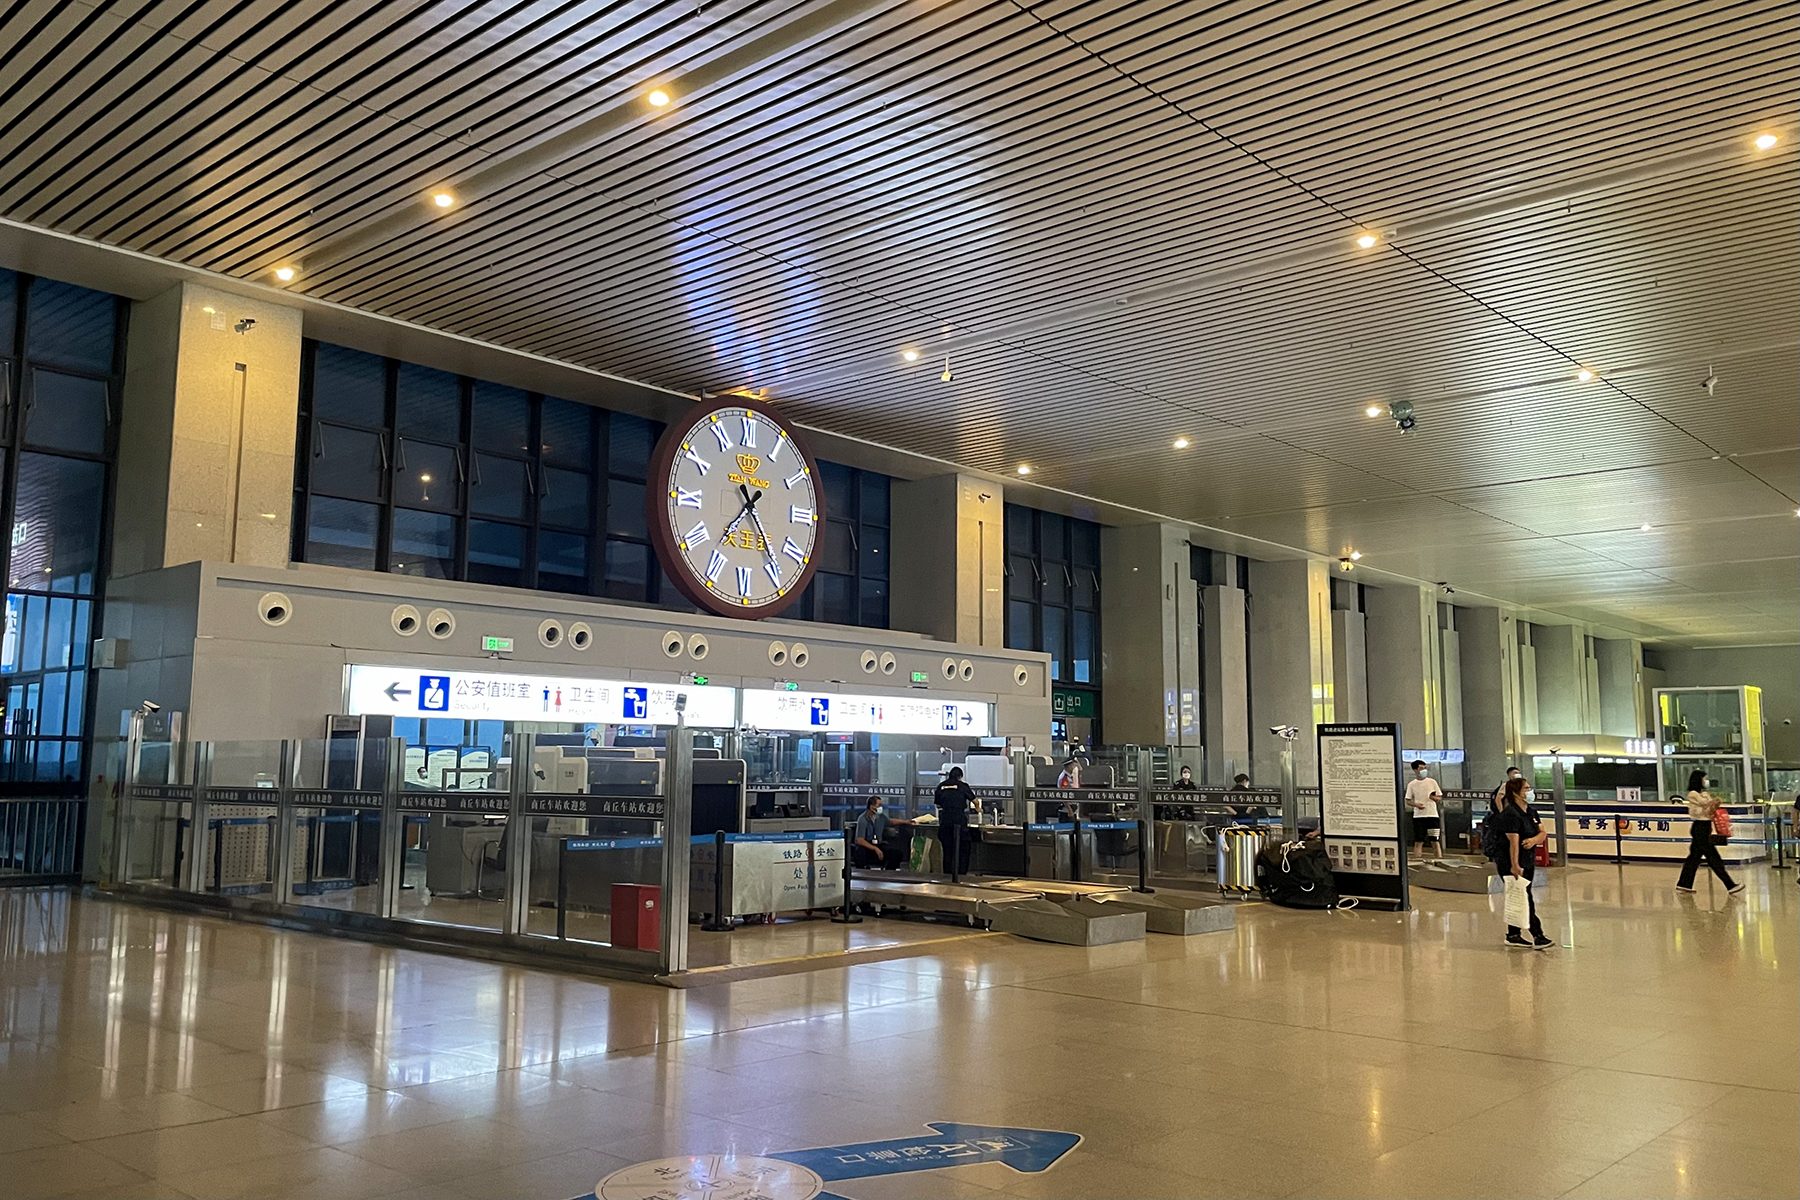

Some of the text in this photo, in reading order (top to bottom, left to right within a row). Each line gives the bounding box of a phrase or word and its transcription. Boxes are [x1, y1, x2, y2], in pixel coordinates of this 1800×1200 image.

[741, 417, 757, 448] XII
[685, 445, 711, 476] X
[748, 477, 770, 489] WANG
[676, 486, 702, 509] IX
[791, 504, 813, 526] III
[684, 520, 711, 551] VIII
[737, 566, 752, 596] VI
[455, 679, 531, 699] 公安值班室
[569, 686, 610, 705] 卫生间
[531, 798, 587, 811] 商丘车站欢迎您
[603, 802, 663, 814] 商丘车站欢迎您
[782, 849, 802, 859] 铁路
[926, 1144, 980, 1158] A1
